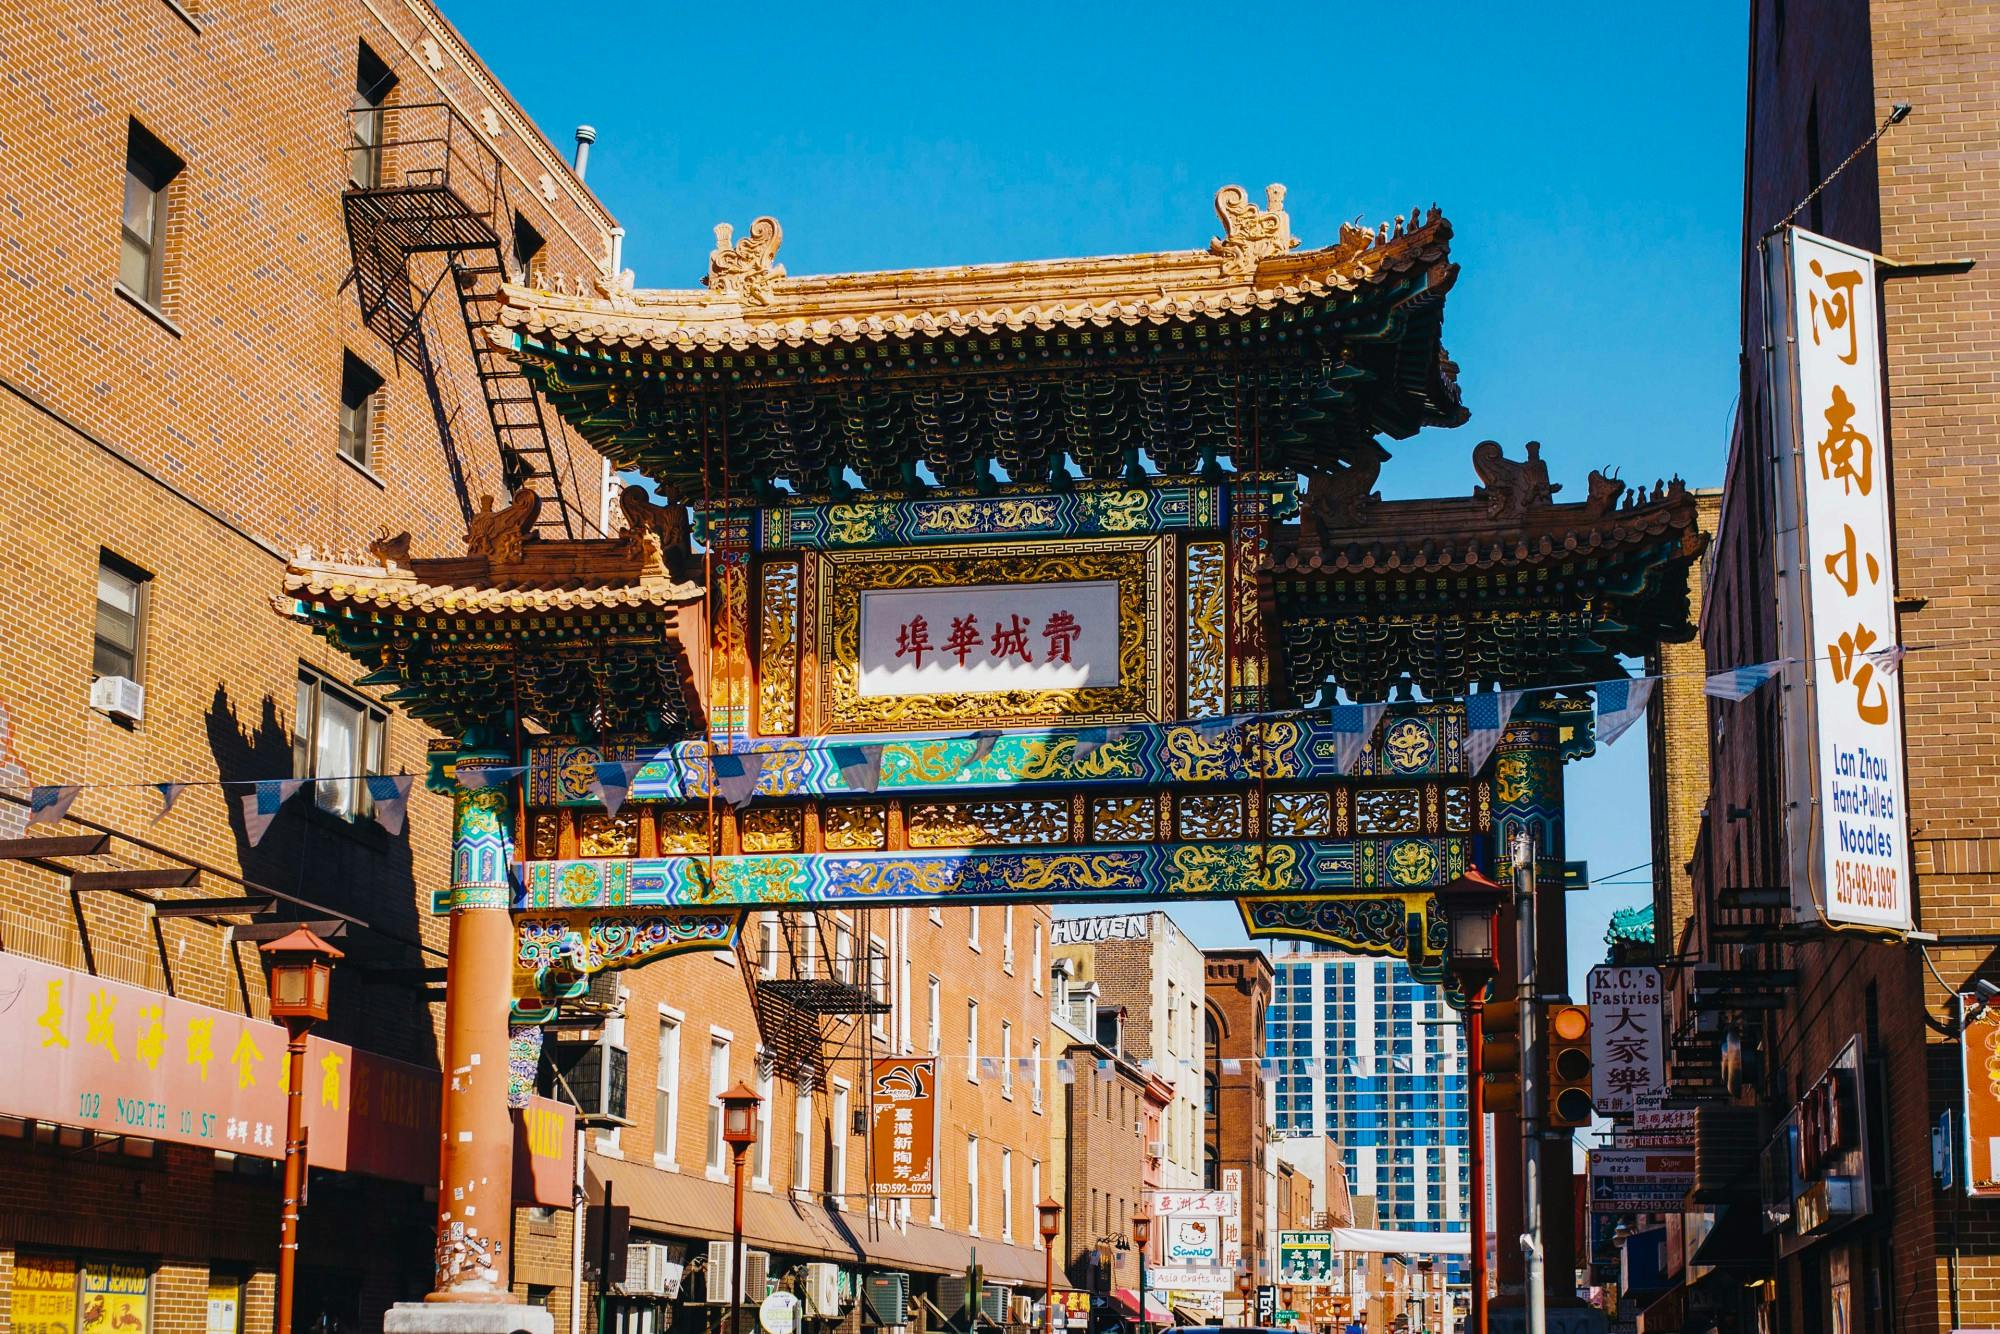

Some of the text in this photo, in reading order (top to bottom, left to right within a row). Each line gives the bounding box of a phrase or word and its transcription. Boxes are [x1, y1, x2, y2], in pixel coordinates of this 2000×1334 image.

[1808, 258, 1889, 726] 河南小吃
[1833, 744, 1888, 782] Lan Zhou
[1832, 780, 1893, 820] Hand-Pulled
[1839, 820, 1892, 858] Noodles
[1835, 859, 1897, 910] 215-982-1997
[1594, 969, 1656, 989] K.C.'s
[1592, 991, 1660, 1005] Pastries
[1605, 1007, 1650, 1095] 大家樂
[79, 1093, 215, 1137] 102 NORTH 10 ST
[1636, 1096, 1660, 1107] Gregor
[870, 1183, 932, 1193] (215)592-0739
[1173, 1245, 1213, 1257] Sanrio
[1283, 1234, 1329, 1244] TAI LAKE
[86, 1263, 108, 1291] RESH
[109, 1264, 145, 1294] SEAFOOD
[1157, 1273, 1178, 1282] Asia
[1180, 1273, 1210, 1286] Crafts
